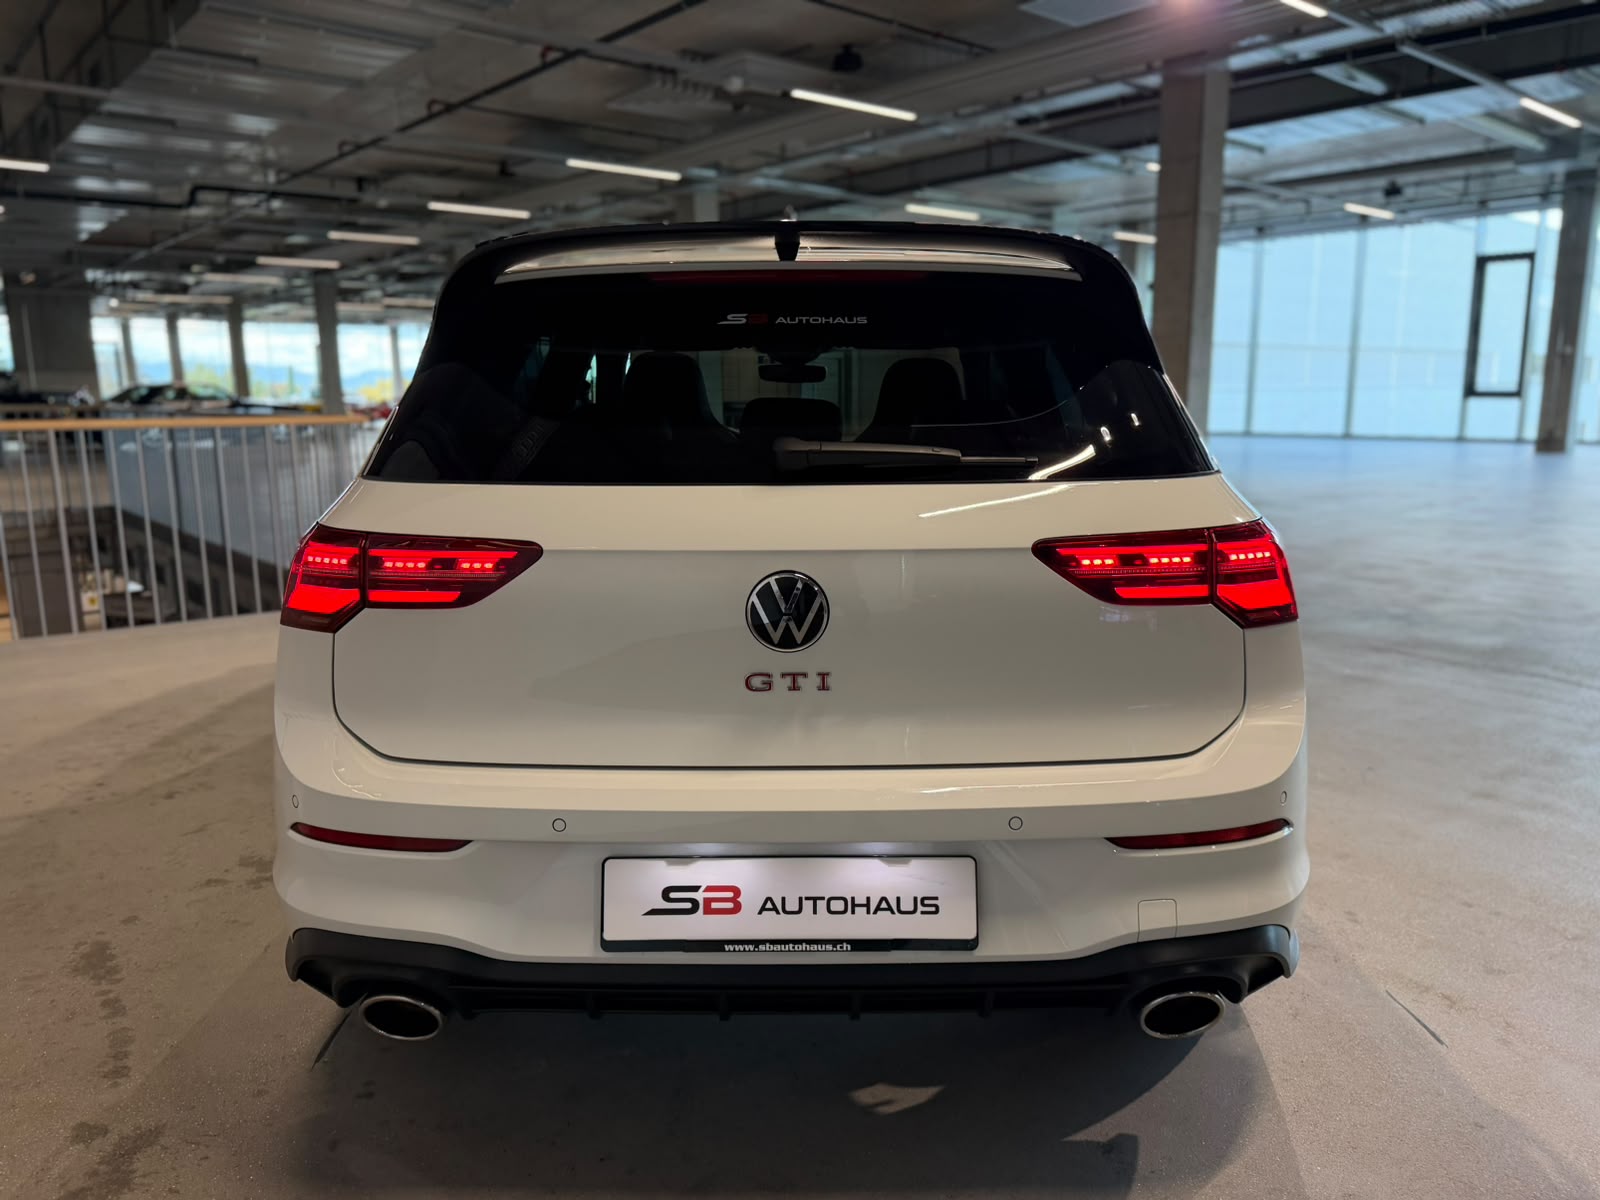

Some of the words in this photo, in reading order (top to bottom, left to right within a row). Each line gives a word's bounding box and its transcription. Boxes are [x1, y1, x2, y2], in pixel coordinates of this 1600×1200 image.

[717, 313, 769, 325] SB
[775, 316, 868, 325] AUTOHAUS
[744, 672, 832, 692] GTI
[641, 885, 742, 916] SB
[757, 896, 941, 916] AUTOHAUS
[724, 941, 852, 953] www.sbautohaus.ch
